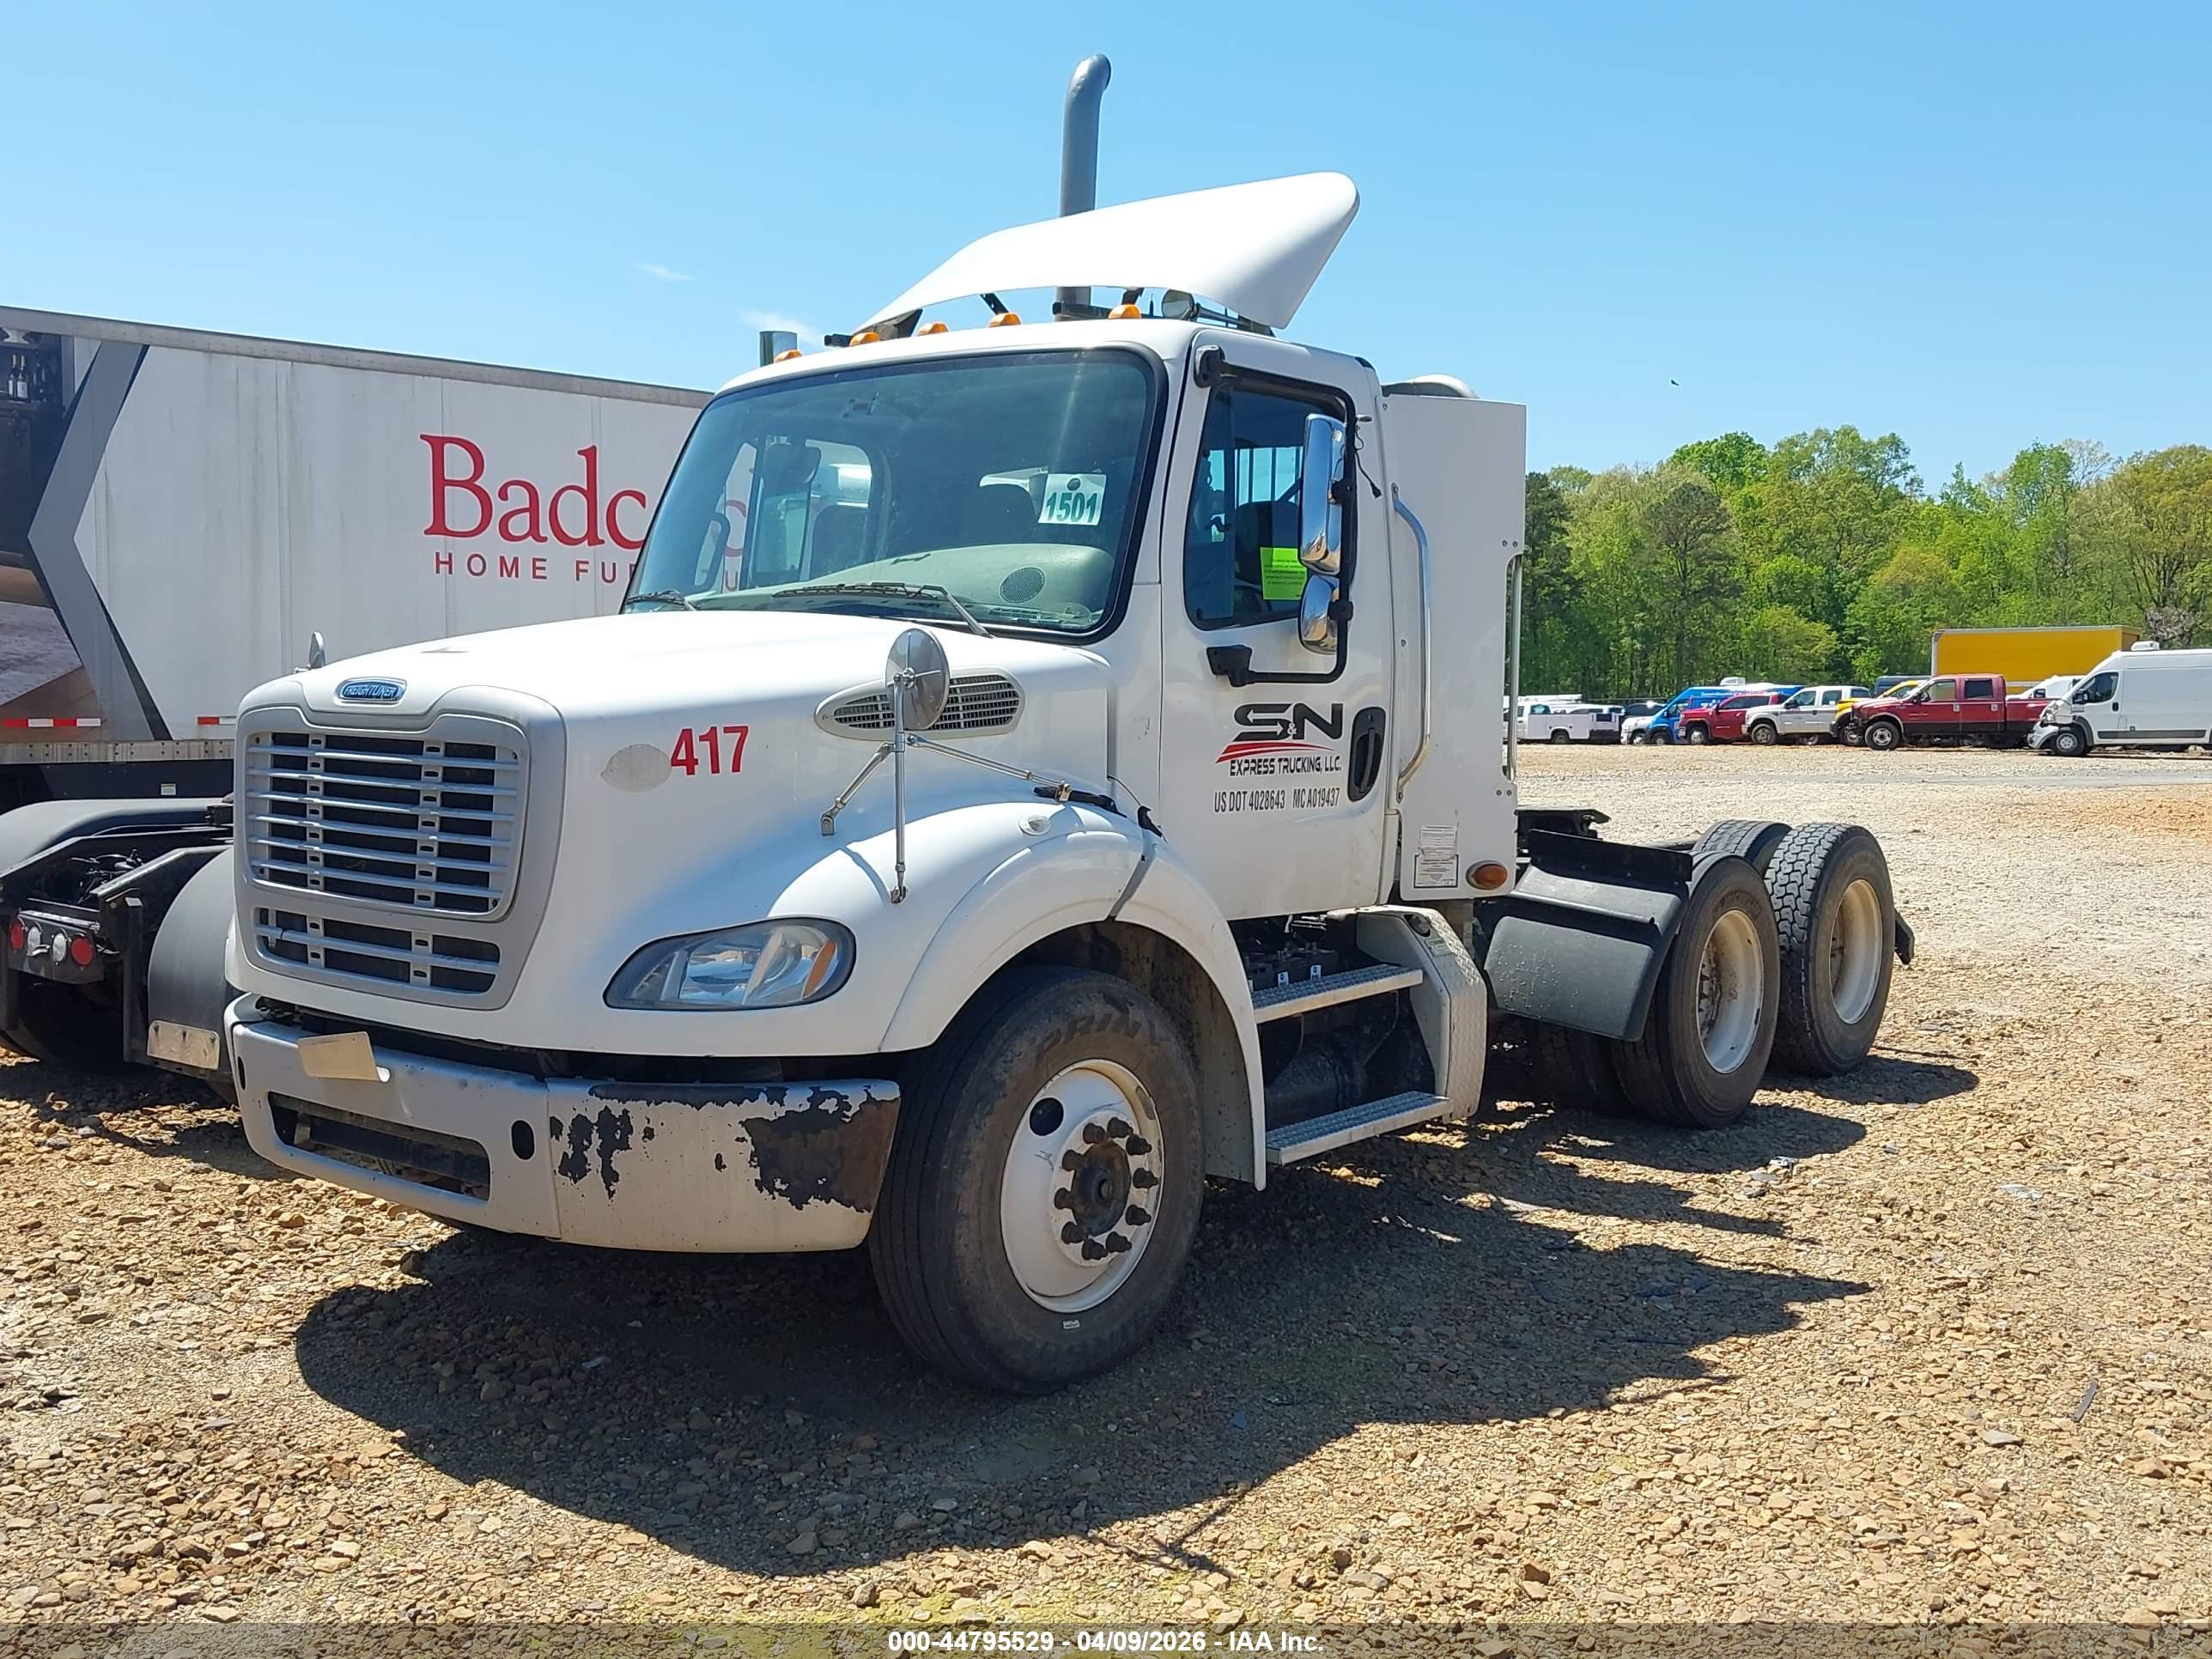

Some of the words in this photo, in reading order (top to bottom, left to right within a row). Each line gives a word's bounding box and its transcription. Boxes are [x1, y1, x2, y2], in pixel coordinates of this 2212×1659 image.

[1045, 491, 1098, 523] 1501
[434, 551, 548, 580] HOME
[343, 684, 398, 699] FREIGHTLINER
[670, 725, 750, 776] 417
[1230, 757, 1275, 776] EXPRESS
[1277, 756, 1322, 775] TRUCKING,
[1324, 755, 1342, 772] LLC.
[1214, 791, 1227, 812] US
[1229, 790, 1248, 811] DOT
[1249, 789, 1285, 811] 4028643
[1292, 787, 1306, 809] MC
[1307, 787, 1340, 808] A019437
